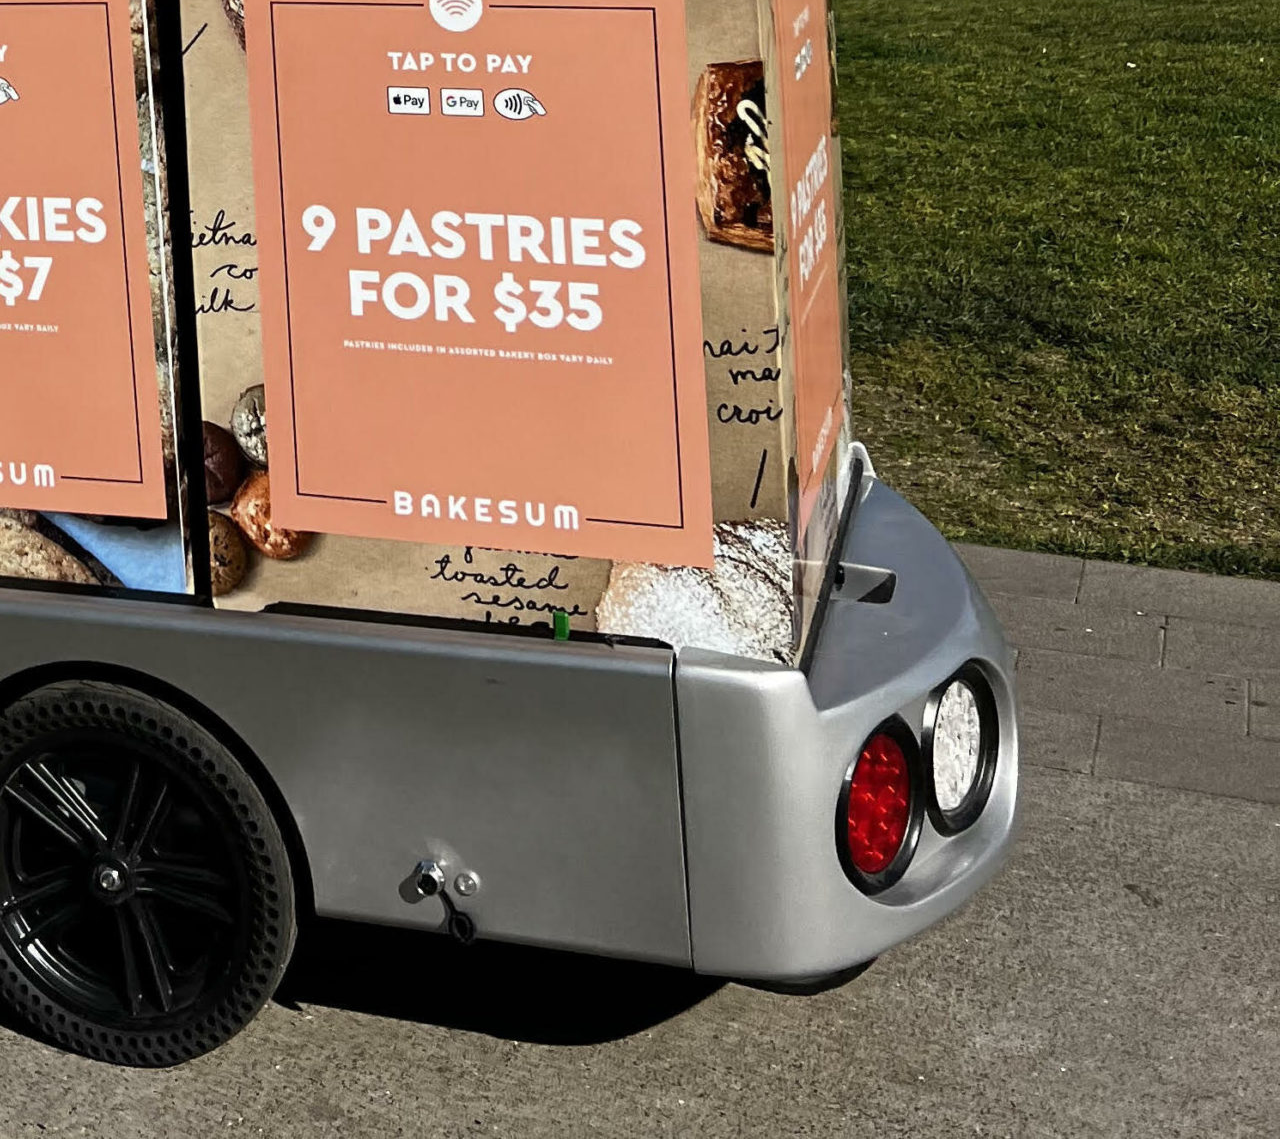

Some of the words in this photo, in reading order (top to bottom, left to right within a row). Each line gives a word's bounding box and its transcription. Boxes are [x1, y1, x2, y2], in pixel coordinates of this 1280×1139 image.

[387, 51, 435, 72] TAP
[440, 52, 477, 73] TO
[486, 54, 532, 74] PAY
[403, 94, 425, 109] Pay
[301, 204, 337, 252] 9
[355, 207, 646, 269] PASTRIES
[348, 269, 476, 323] FOR
[493, 272, 603, 333] $35
[343, 339, 385, 350] PASTRIES
[388, 342, 434, 353] INCLUDED
[448, 347, 496, 358] ASSORTED
[393, 490, 580, 531] BAKESUM
[430, 554, 570, 590] toasted
[461, 592, 588, 616] sesame
